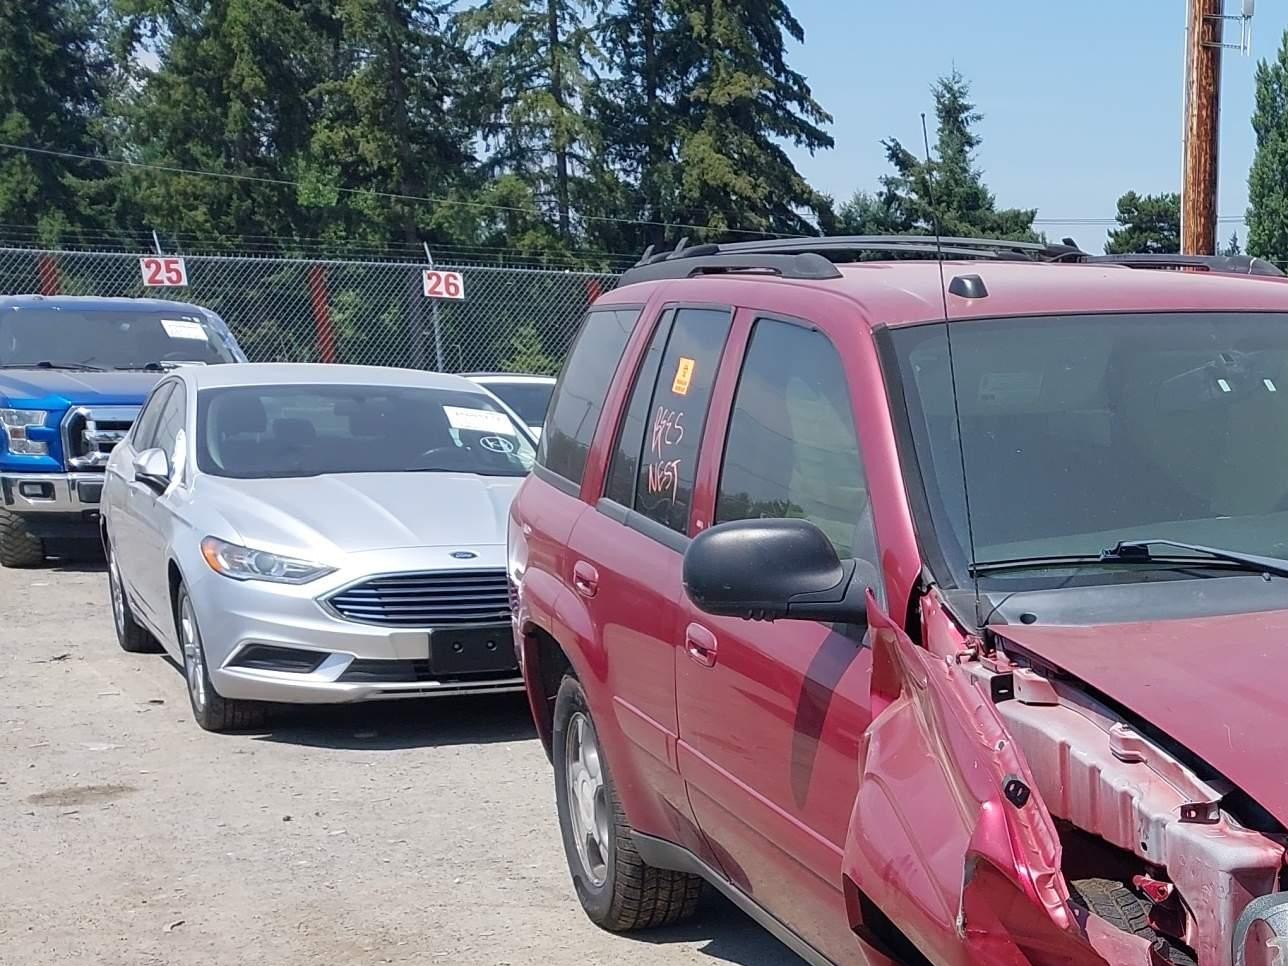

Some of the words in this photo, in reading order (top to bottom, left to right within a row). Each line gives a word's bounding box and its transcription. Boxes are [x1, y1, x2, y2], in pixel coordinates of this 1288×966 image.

[144, 259, 182, 285] 25
[427, 272, 460, 297] 26
[648, 459, 681, 506] NEST
